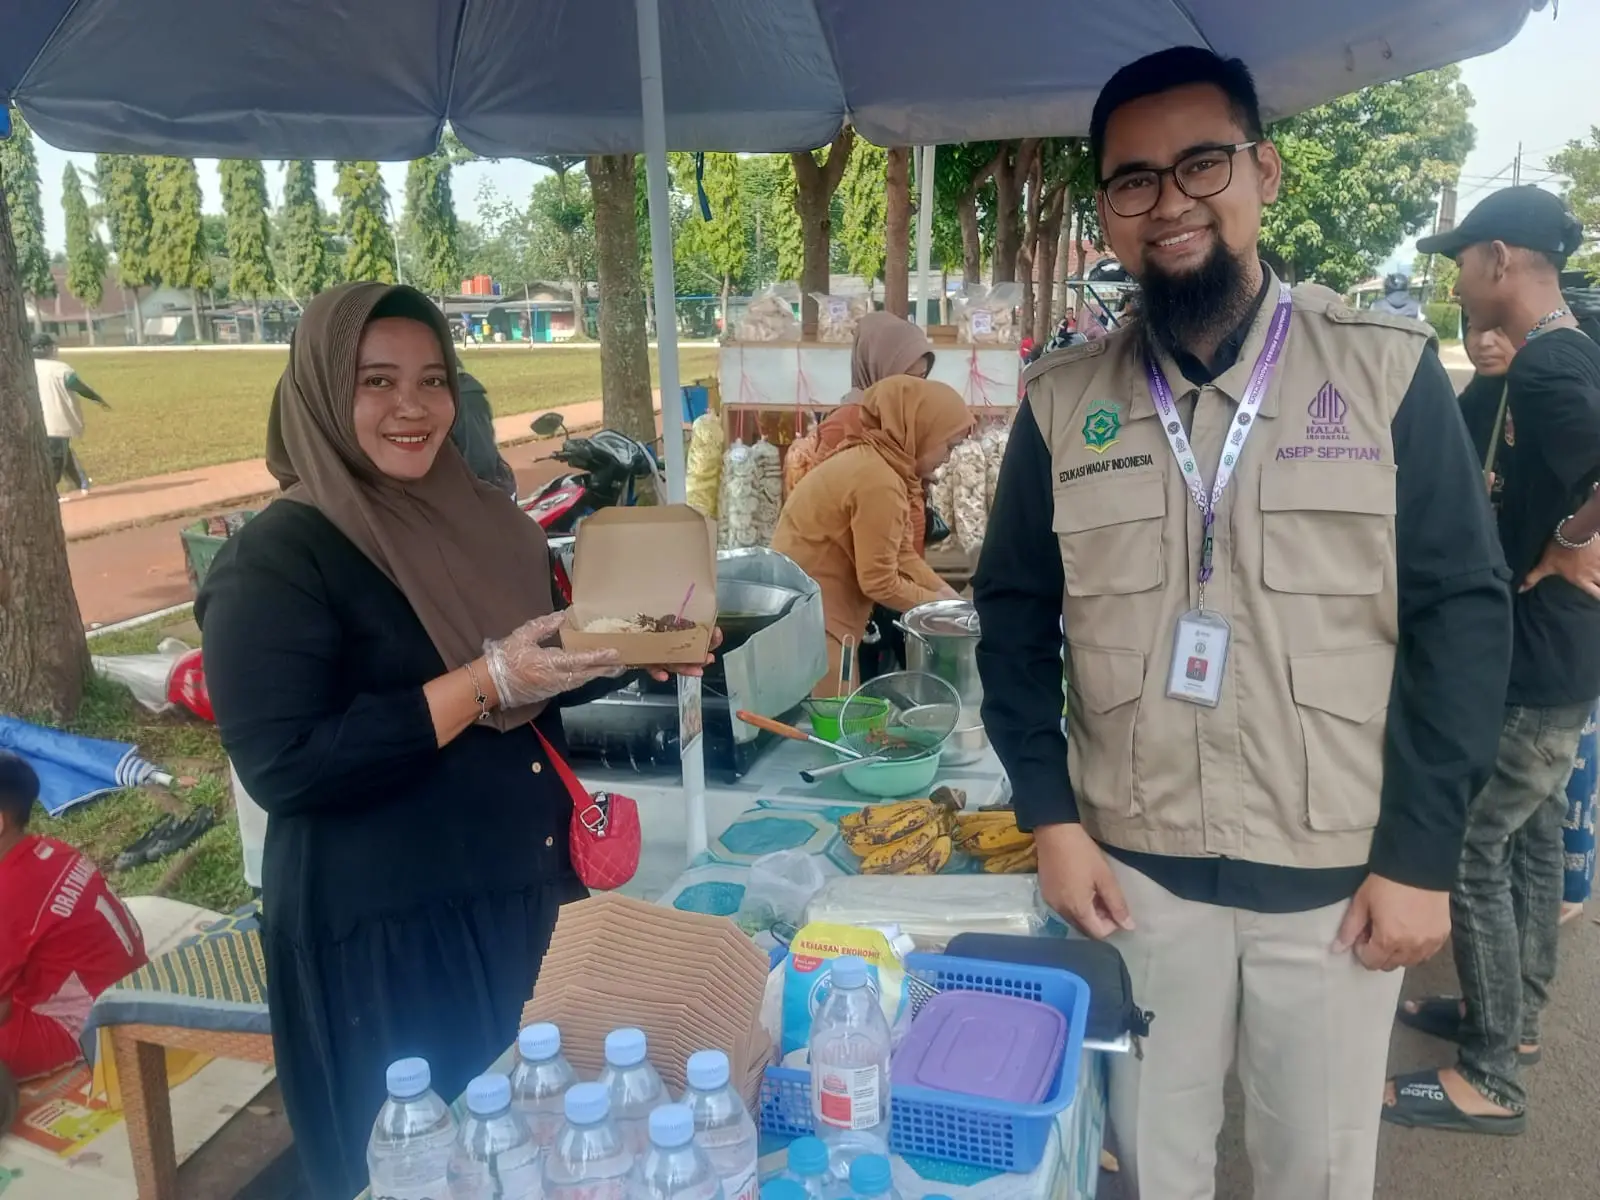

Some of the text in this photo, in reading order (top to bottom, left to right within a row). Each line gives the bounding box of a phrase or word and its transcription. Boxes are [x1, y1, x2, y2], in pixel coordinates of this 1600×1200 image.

[1275, 446, 1381, 461] ASEP SEPTIAN
[1059, 454, 1154, 483] EDUKASI WAQAF INDONESIA
[800, 940, 840, 954] KEMASAN
